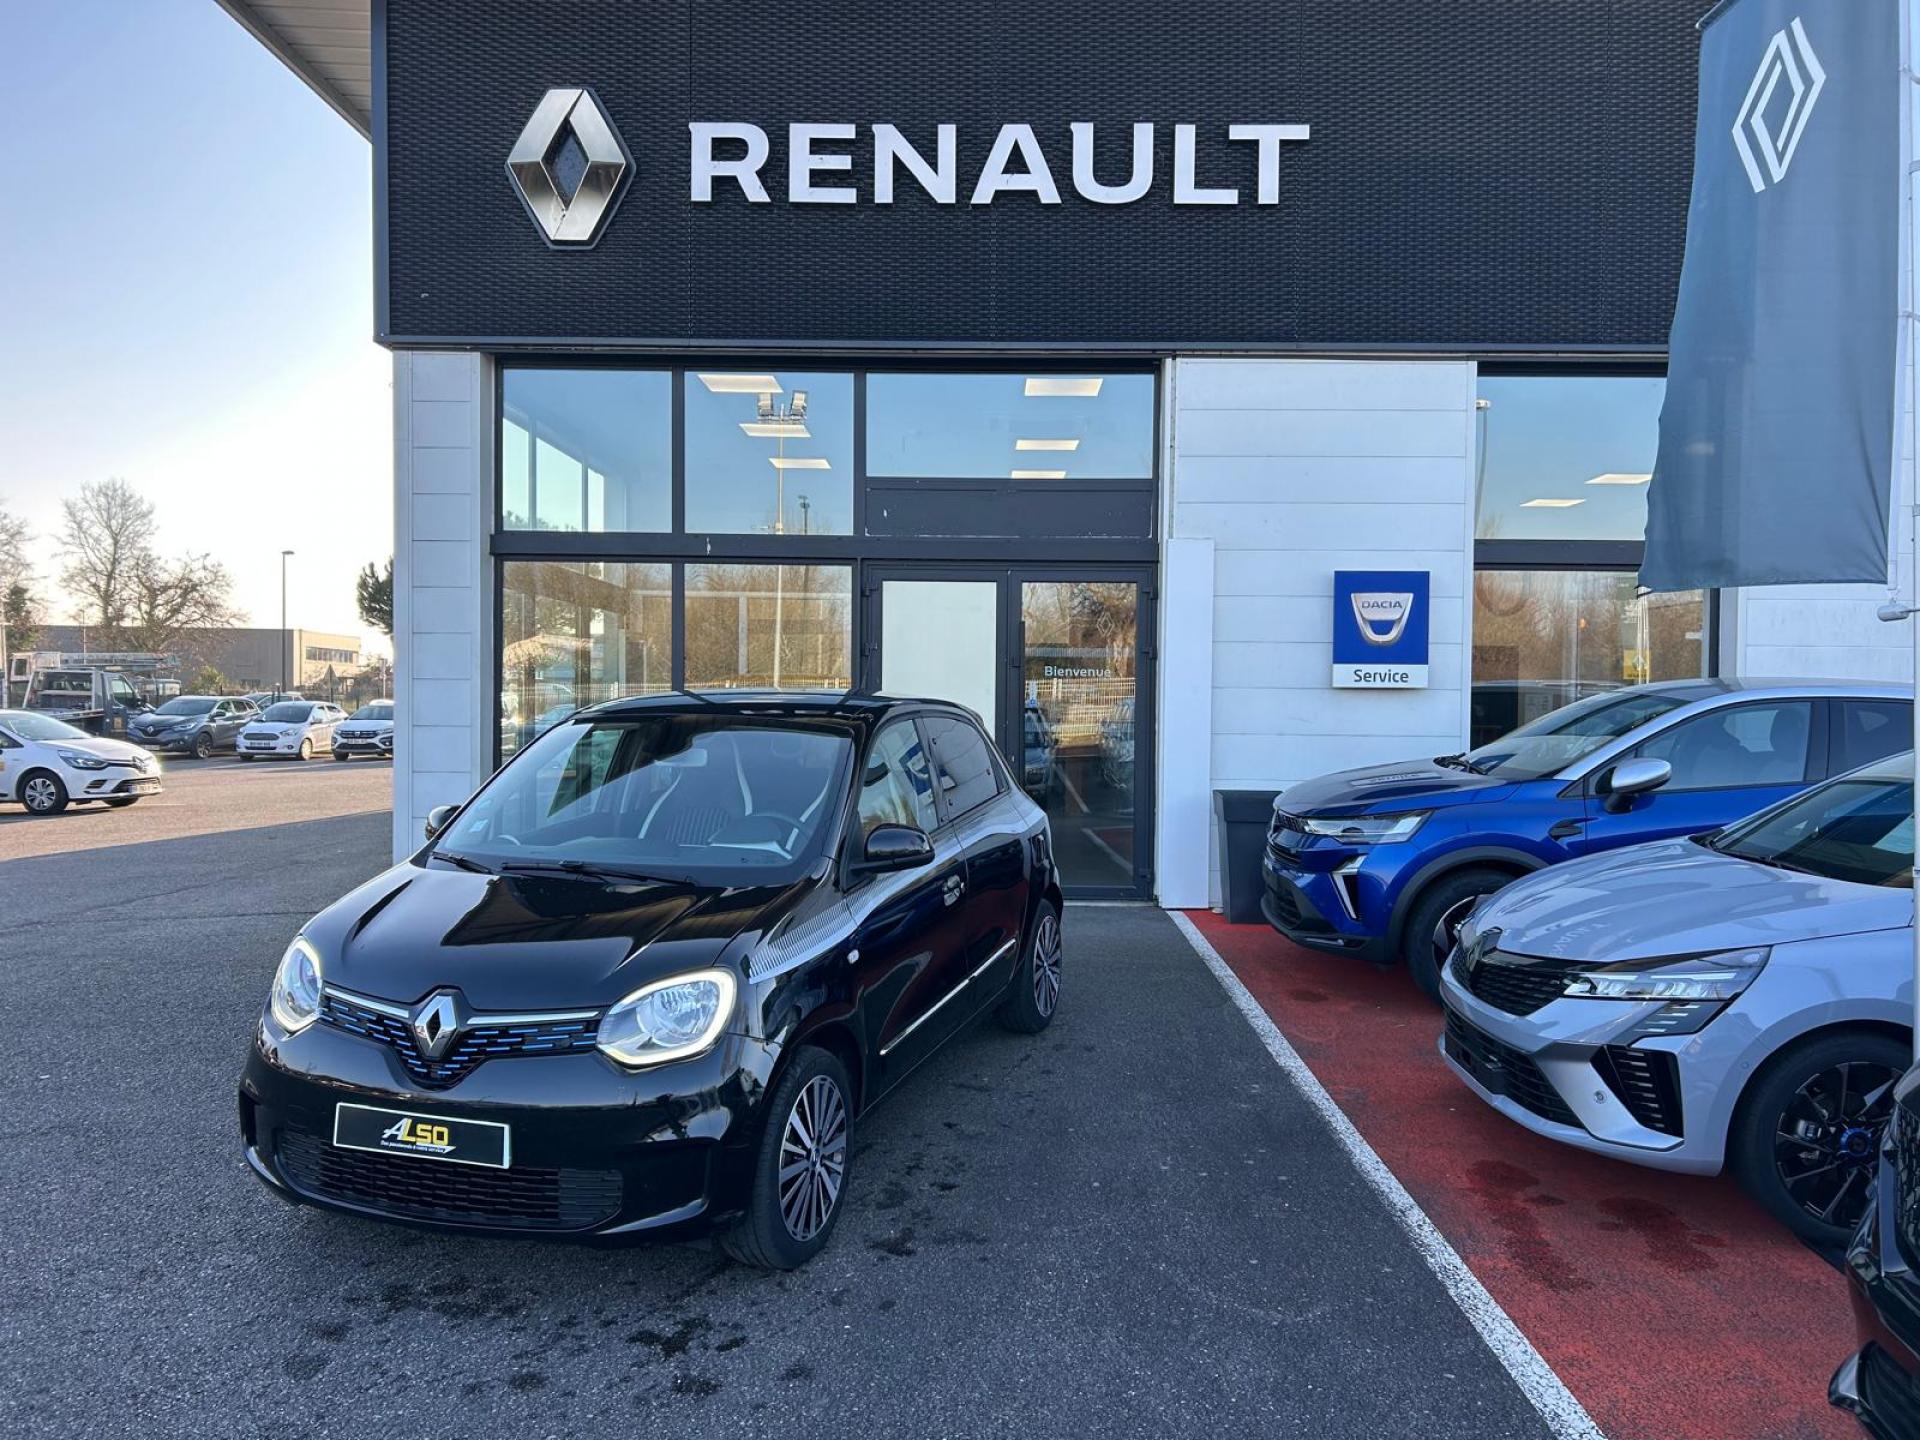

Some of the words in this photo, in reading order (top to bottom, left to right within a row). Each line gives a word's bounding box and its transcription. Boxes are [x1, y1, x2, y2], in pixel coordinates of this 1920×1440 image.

[688, 121, 1311, 206] RENAULT
[1361, 600, 1403, 609] DACIA
[1044, 665, 1111, 678] Bienvenue
[1353, 669, 1409, 683] Service
[381, 1118, 449, 1146] ALSO
